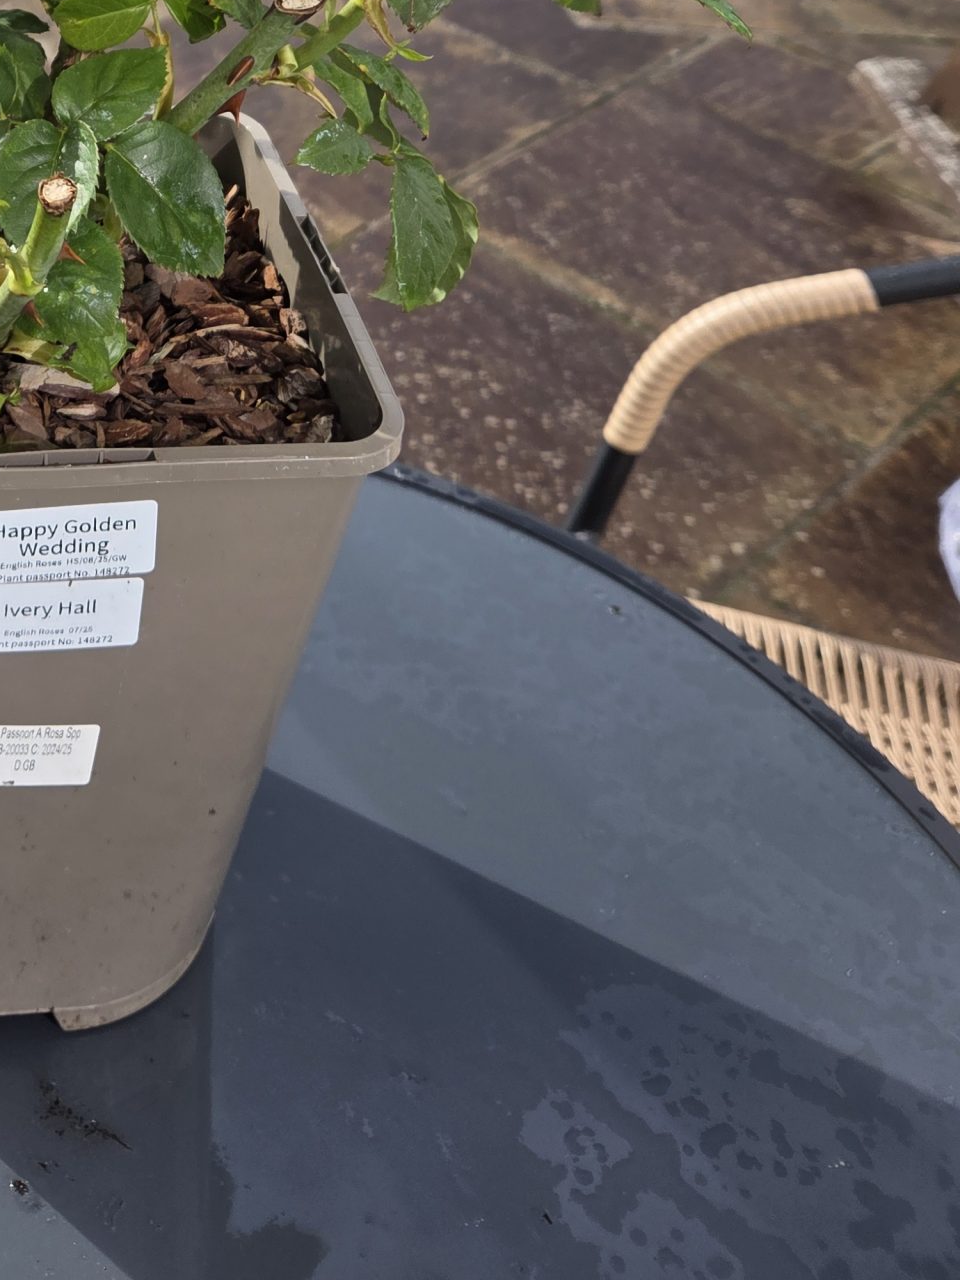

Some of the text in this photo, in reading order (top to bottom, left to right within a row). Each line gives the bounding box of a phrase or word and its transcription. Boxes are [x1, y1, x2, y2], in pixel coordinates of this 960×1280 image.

[64, 516, 137, 534] Golden
[19, 538, 110, 557] Wedding
[0, 561, 33, 571] English
[36, 559, 62, 568] Roses
[26, 571, 71, 582] passport
[4, 599, 97, 620] Ivery Hall
[3, 628, 36, 638] English
[10, 638, 55, 650] passport
